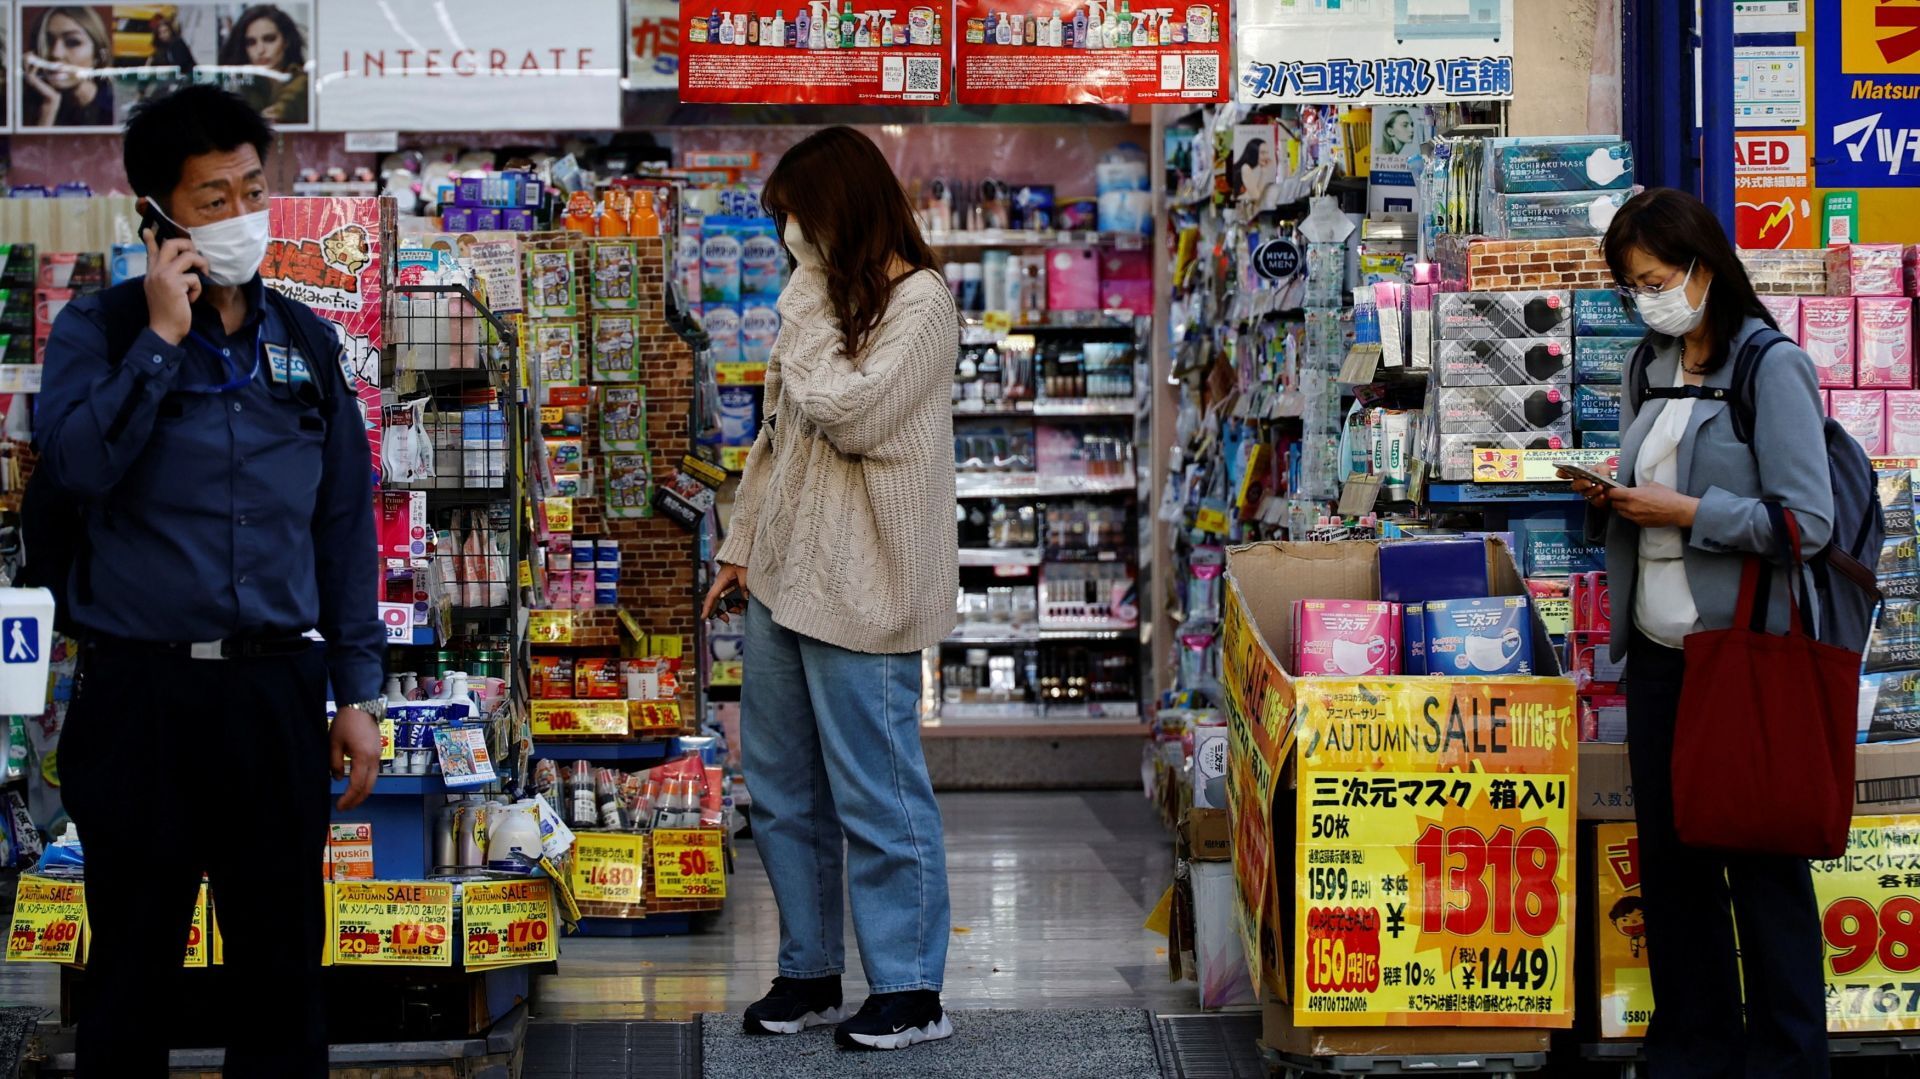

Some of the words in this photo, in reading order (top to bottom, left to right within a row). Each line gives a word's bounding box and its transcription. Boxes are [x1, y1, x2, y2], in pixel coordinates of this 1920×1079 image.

[342, 48, 595, 78] INTEGRATE
[1240, 57, 1513, 97] タバコ取り扱い店舗
[1509, 161, 1558, 170] KUCHIRAKU
[1559, 160, 1584, 168] MASK
[1510, 209, 1560, 217] KUCHIRAKU
[1561, 207, 1586, 215] MASK
[1266, 252, 1296, 261] NIVEA
[1268, 260, 1293, 269] MEN
[1580, 306, 1624, 314] KUCHIRAK
[1804, 309, 1851, 322] 三次元
[1861, 309, 1909, 323] 三次元
[272, 357, 305, 372] SECO
[1581, 353, 1625, 362] KUCHIRAK
[1581, 400, 1620, 408] KUCHIRA
[1391, 439, 1400, 469] GUM
[1534, 547, 1584, 555] KUCHIRAKU
[1321, 616, 1370, 631] 三次元
[1451, 612, 1502, 628] 三次元
[1326, 708, 1386, 720] アニバーサリー
[1325, 724, 1419, 752] AUTUMN
[1422, 696, 1508, 753] SALE
[1510, 703, 1571, 750] 11/15まで
[1312, 778, 1472, 808] 三次元マスク
[1489, 779, 1565, 809] 箱入り
[1592, 785, 1635, 807] 入数3
[1312, 812, 1350, 839] 50枚
[334, 849, 369, 861] yuskin
[678, 849, 706, 876] 50
[590, 865, 634, 886] 1480
[1386, 903, 1407, 938] ¥
[1414, 824, 1560, 937] 1318
[1877, 874, 1920, 889] 各種
[1308, 867, 1348, 900] 1599
[1351, 879, 1371, 899] 円より
[1381, 874, 1409, 896] 本体
[49, 887, 73, 901] SALE
[386, 887, 421, 902] SALE
[424, 888, 446, 897] 11/15
[501, 885, 528, 900] SALE
[350, 904, 384, 915] メンソレータム
[422, 905, 447, 916] 2本パック
[475, 904, 501, 916] メンソレータム
[43, 922, 77, 942] 480
[339, 925, 366, 933] 207
[392, 924, 447, 945] 170
[468, 926, 489, 935] 207
[507, 920, 548, 943] 170
[11, 937, 27, 950] 20
[340, 939, 366, 953] 20
[469, 939, 489, 955] 20
[1312, 938, 1375, 985] 150円引で
[1459, 947, 1477, 964] 税込
[1383, 967, 1401, 986] 税率
[1405, 962, 1436, 986] 10%
[1308, 996, 1367, 1012] 4987067326006
[1408, 996, 1553, 1012] ※こちらは値引き後の価格となっております
